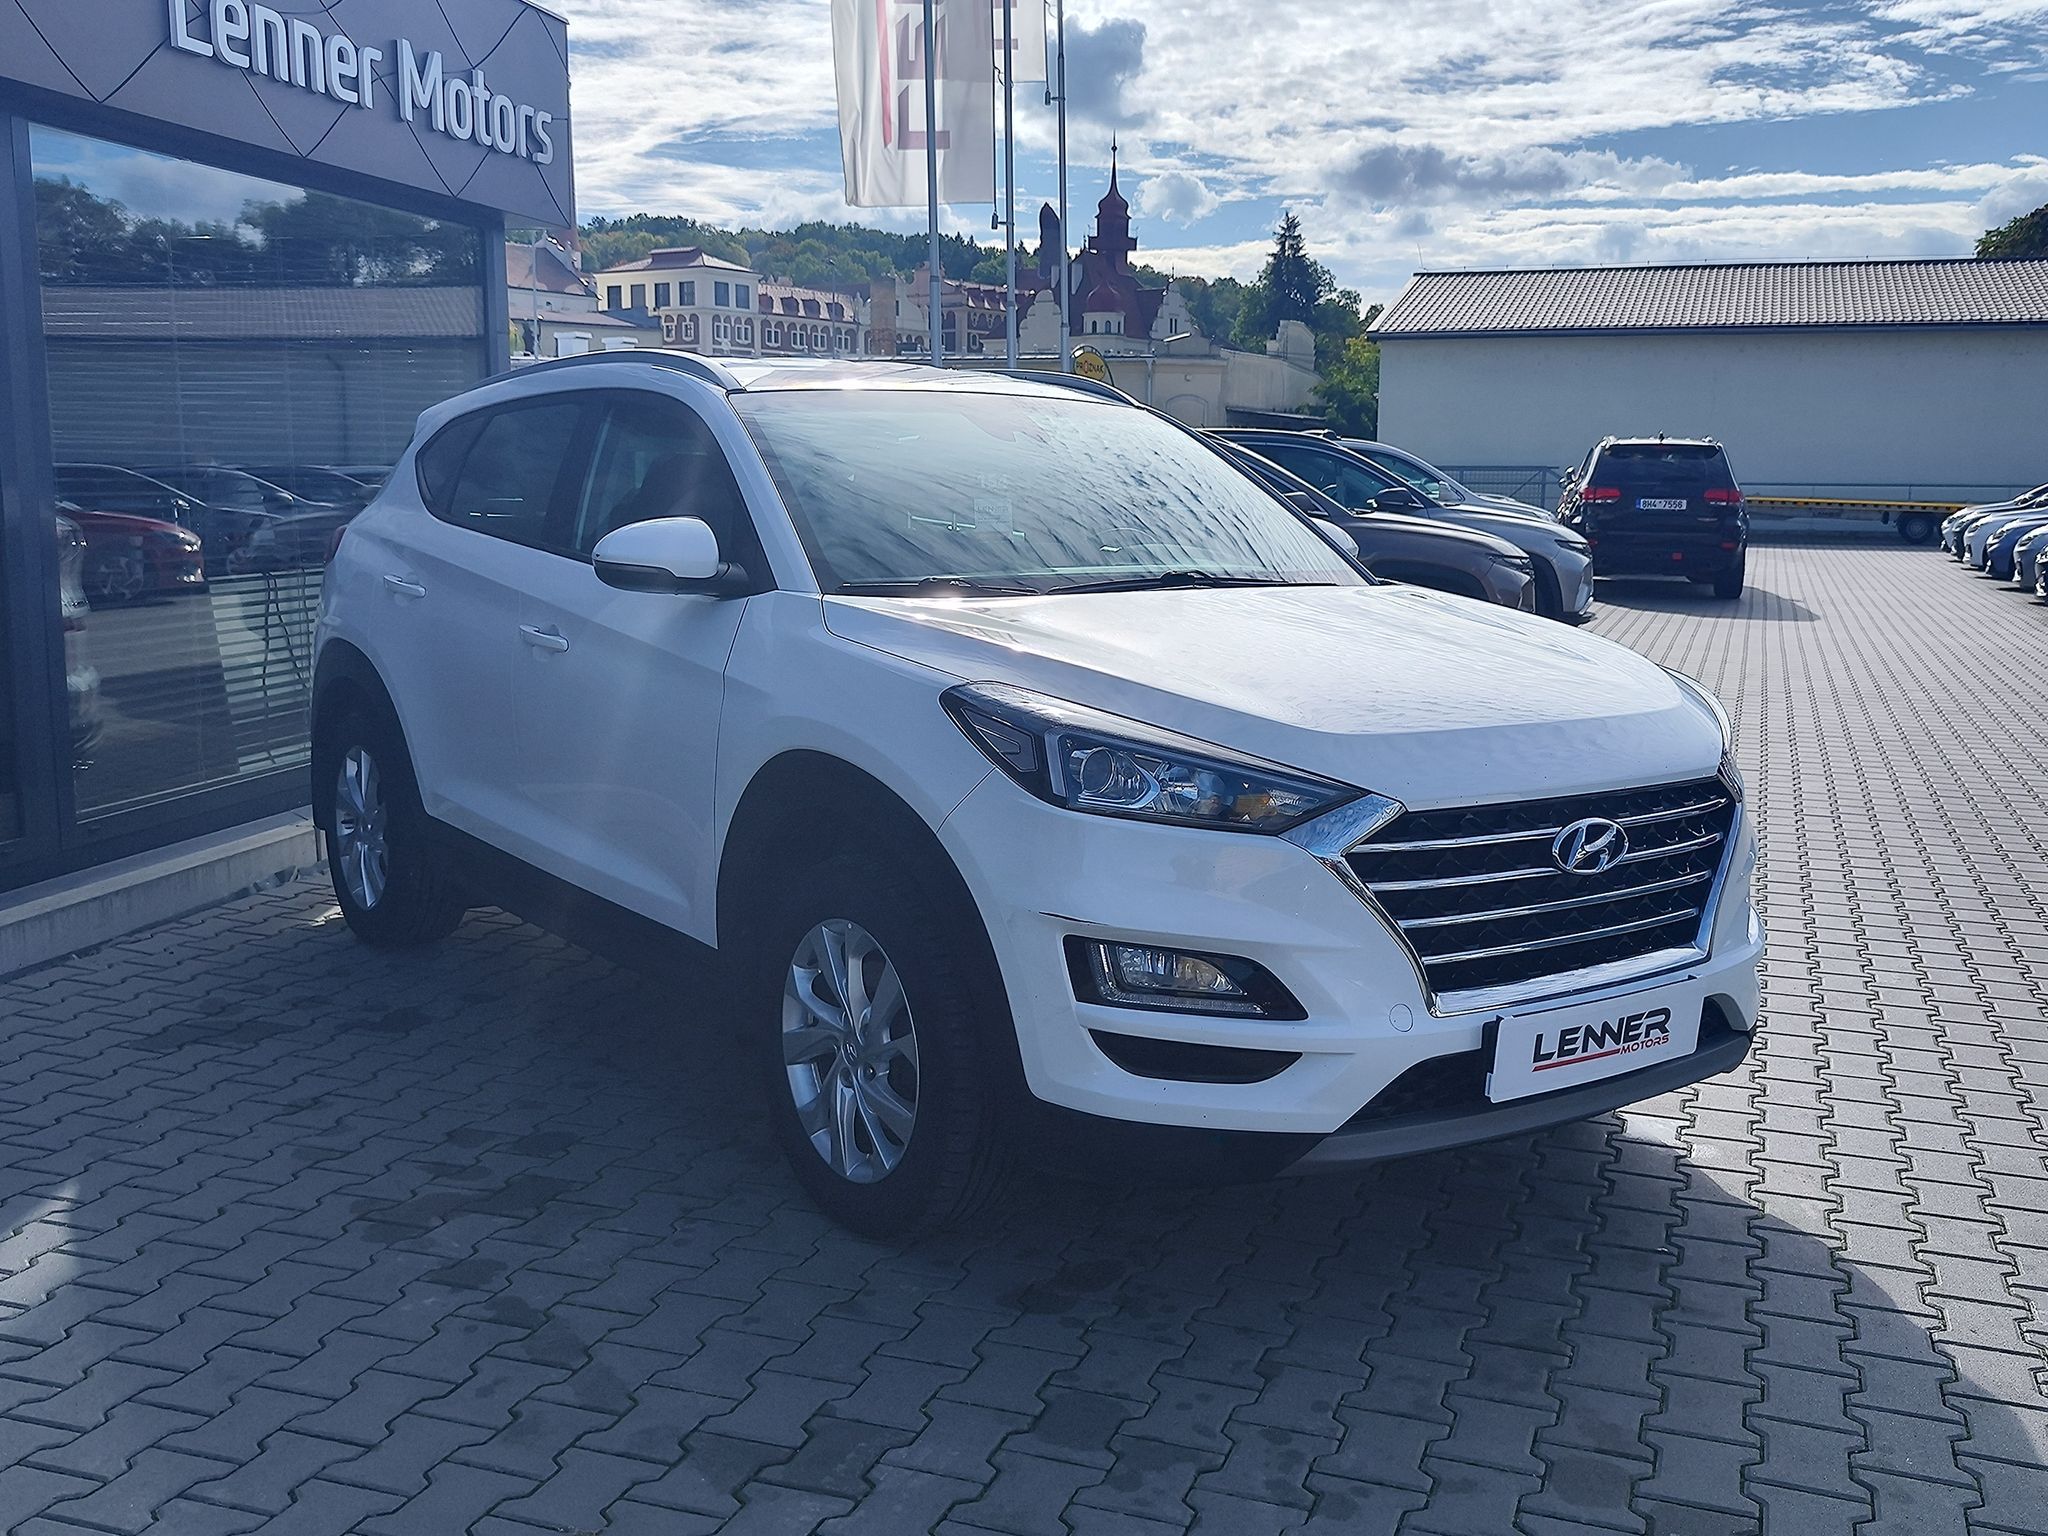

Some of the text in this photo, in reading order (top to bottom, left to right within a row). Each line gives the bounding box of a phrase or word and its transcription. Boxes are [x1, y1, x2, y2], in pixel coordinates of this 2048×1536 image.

[396, 37, 553, 165] Motors
[1533, 1007, 1672, 1063] LENNER
[1619, 1034, 1670, 1055] MOTORS
